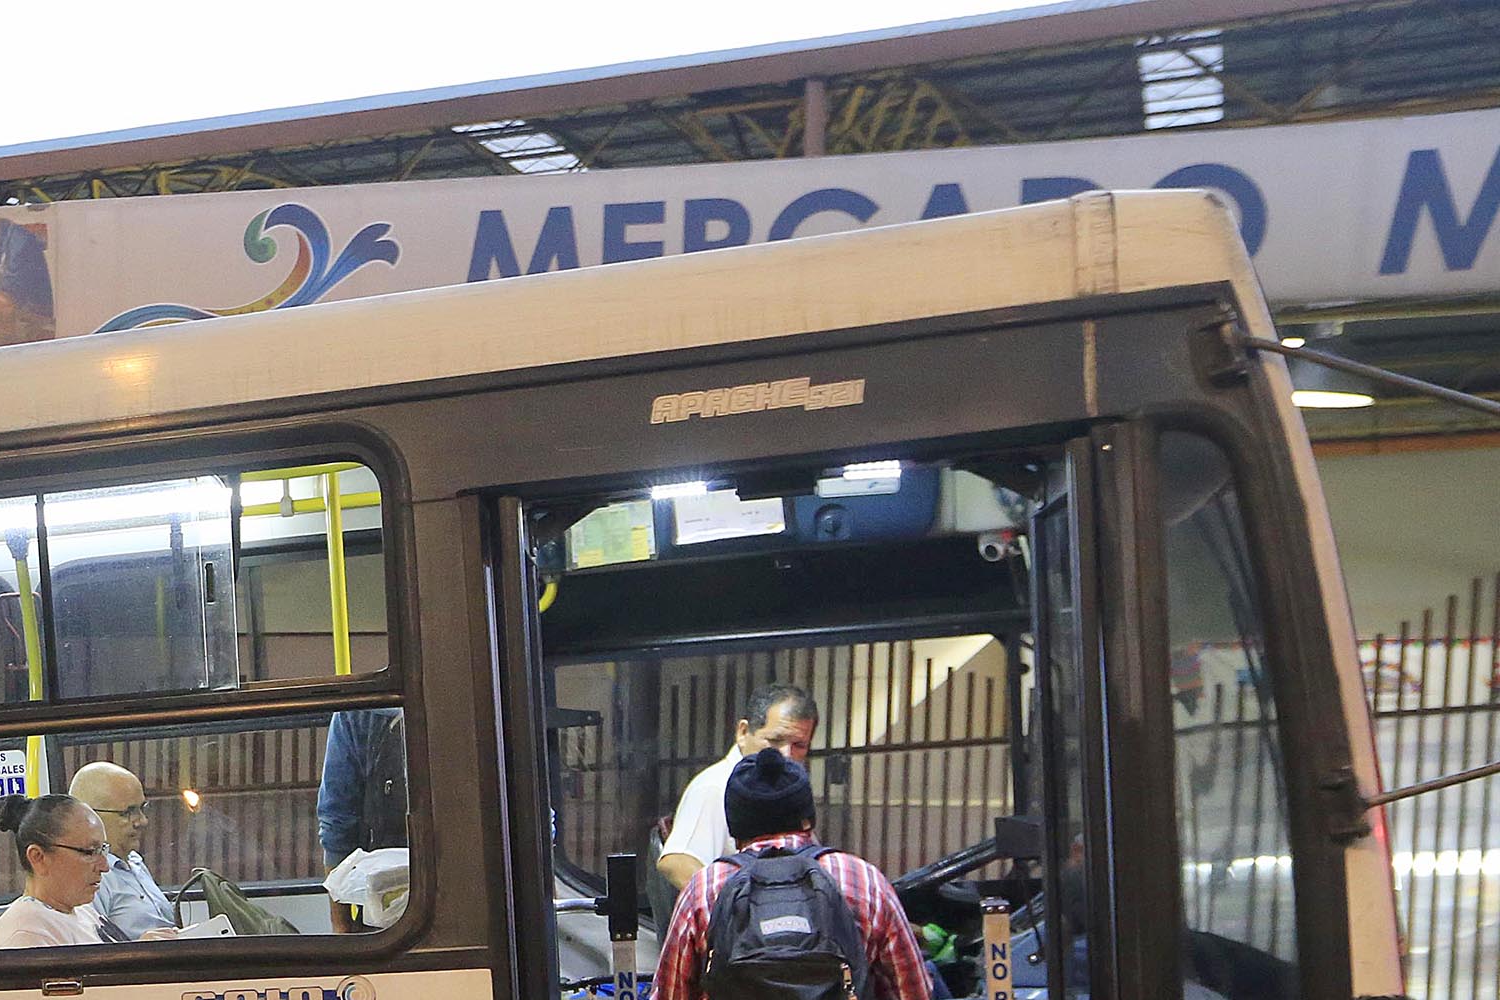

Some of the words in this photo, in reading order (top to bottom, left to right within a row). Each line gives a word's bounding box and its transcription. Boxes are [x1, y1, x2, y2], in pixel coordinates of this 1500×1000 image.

[467, 163, 1268, 283] MERC
[650, 377, 810, 424] APACHE
[990, 943, 1008, 981] NO
